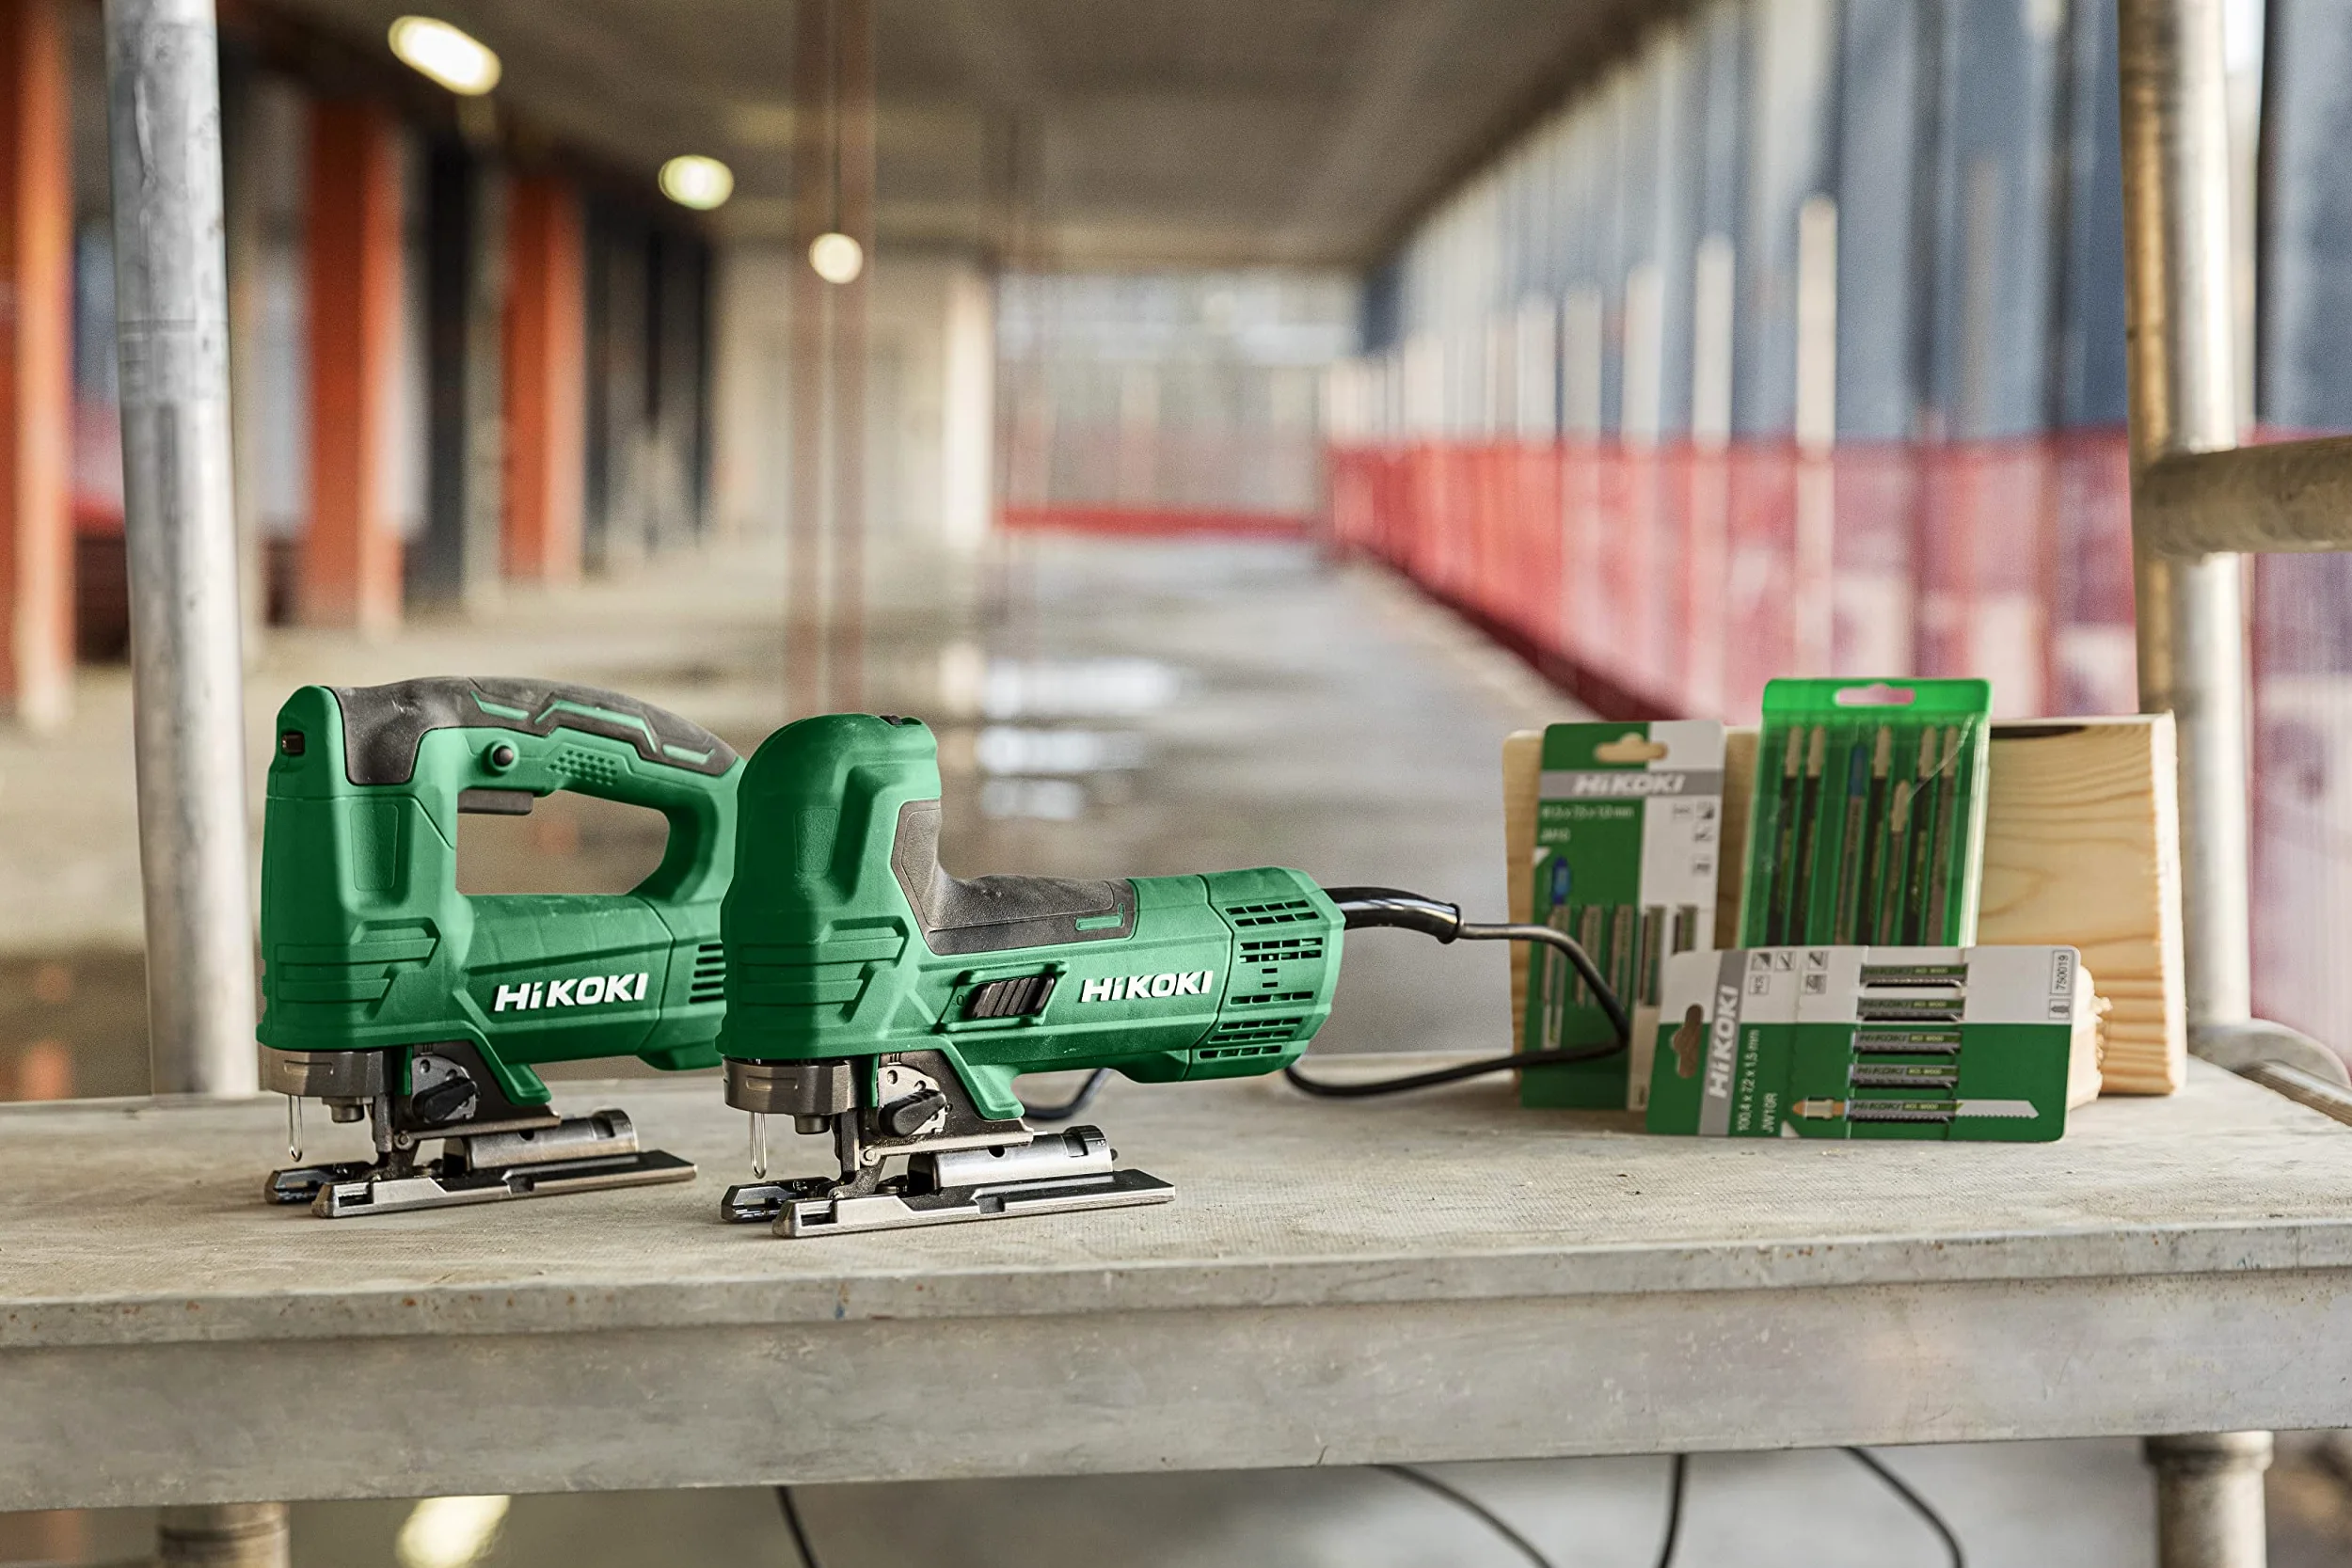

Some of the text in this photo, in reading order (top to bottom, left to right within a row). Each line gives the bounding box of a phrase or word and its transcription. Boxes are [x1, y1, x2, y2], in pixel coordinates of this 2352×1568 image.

[1572, 774, 1687, 795] HiKOKI
[1081, 971, 1214, 1003] HiKOKI
[2056, 955, 2069, 990] 750019
[494, 972, 649, 1012] HiKOKI
[1708, 986, 1739, 1099] HiKOKI
[1748, 1029, 1760, 1051] mm
